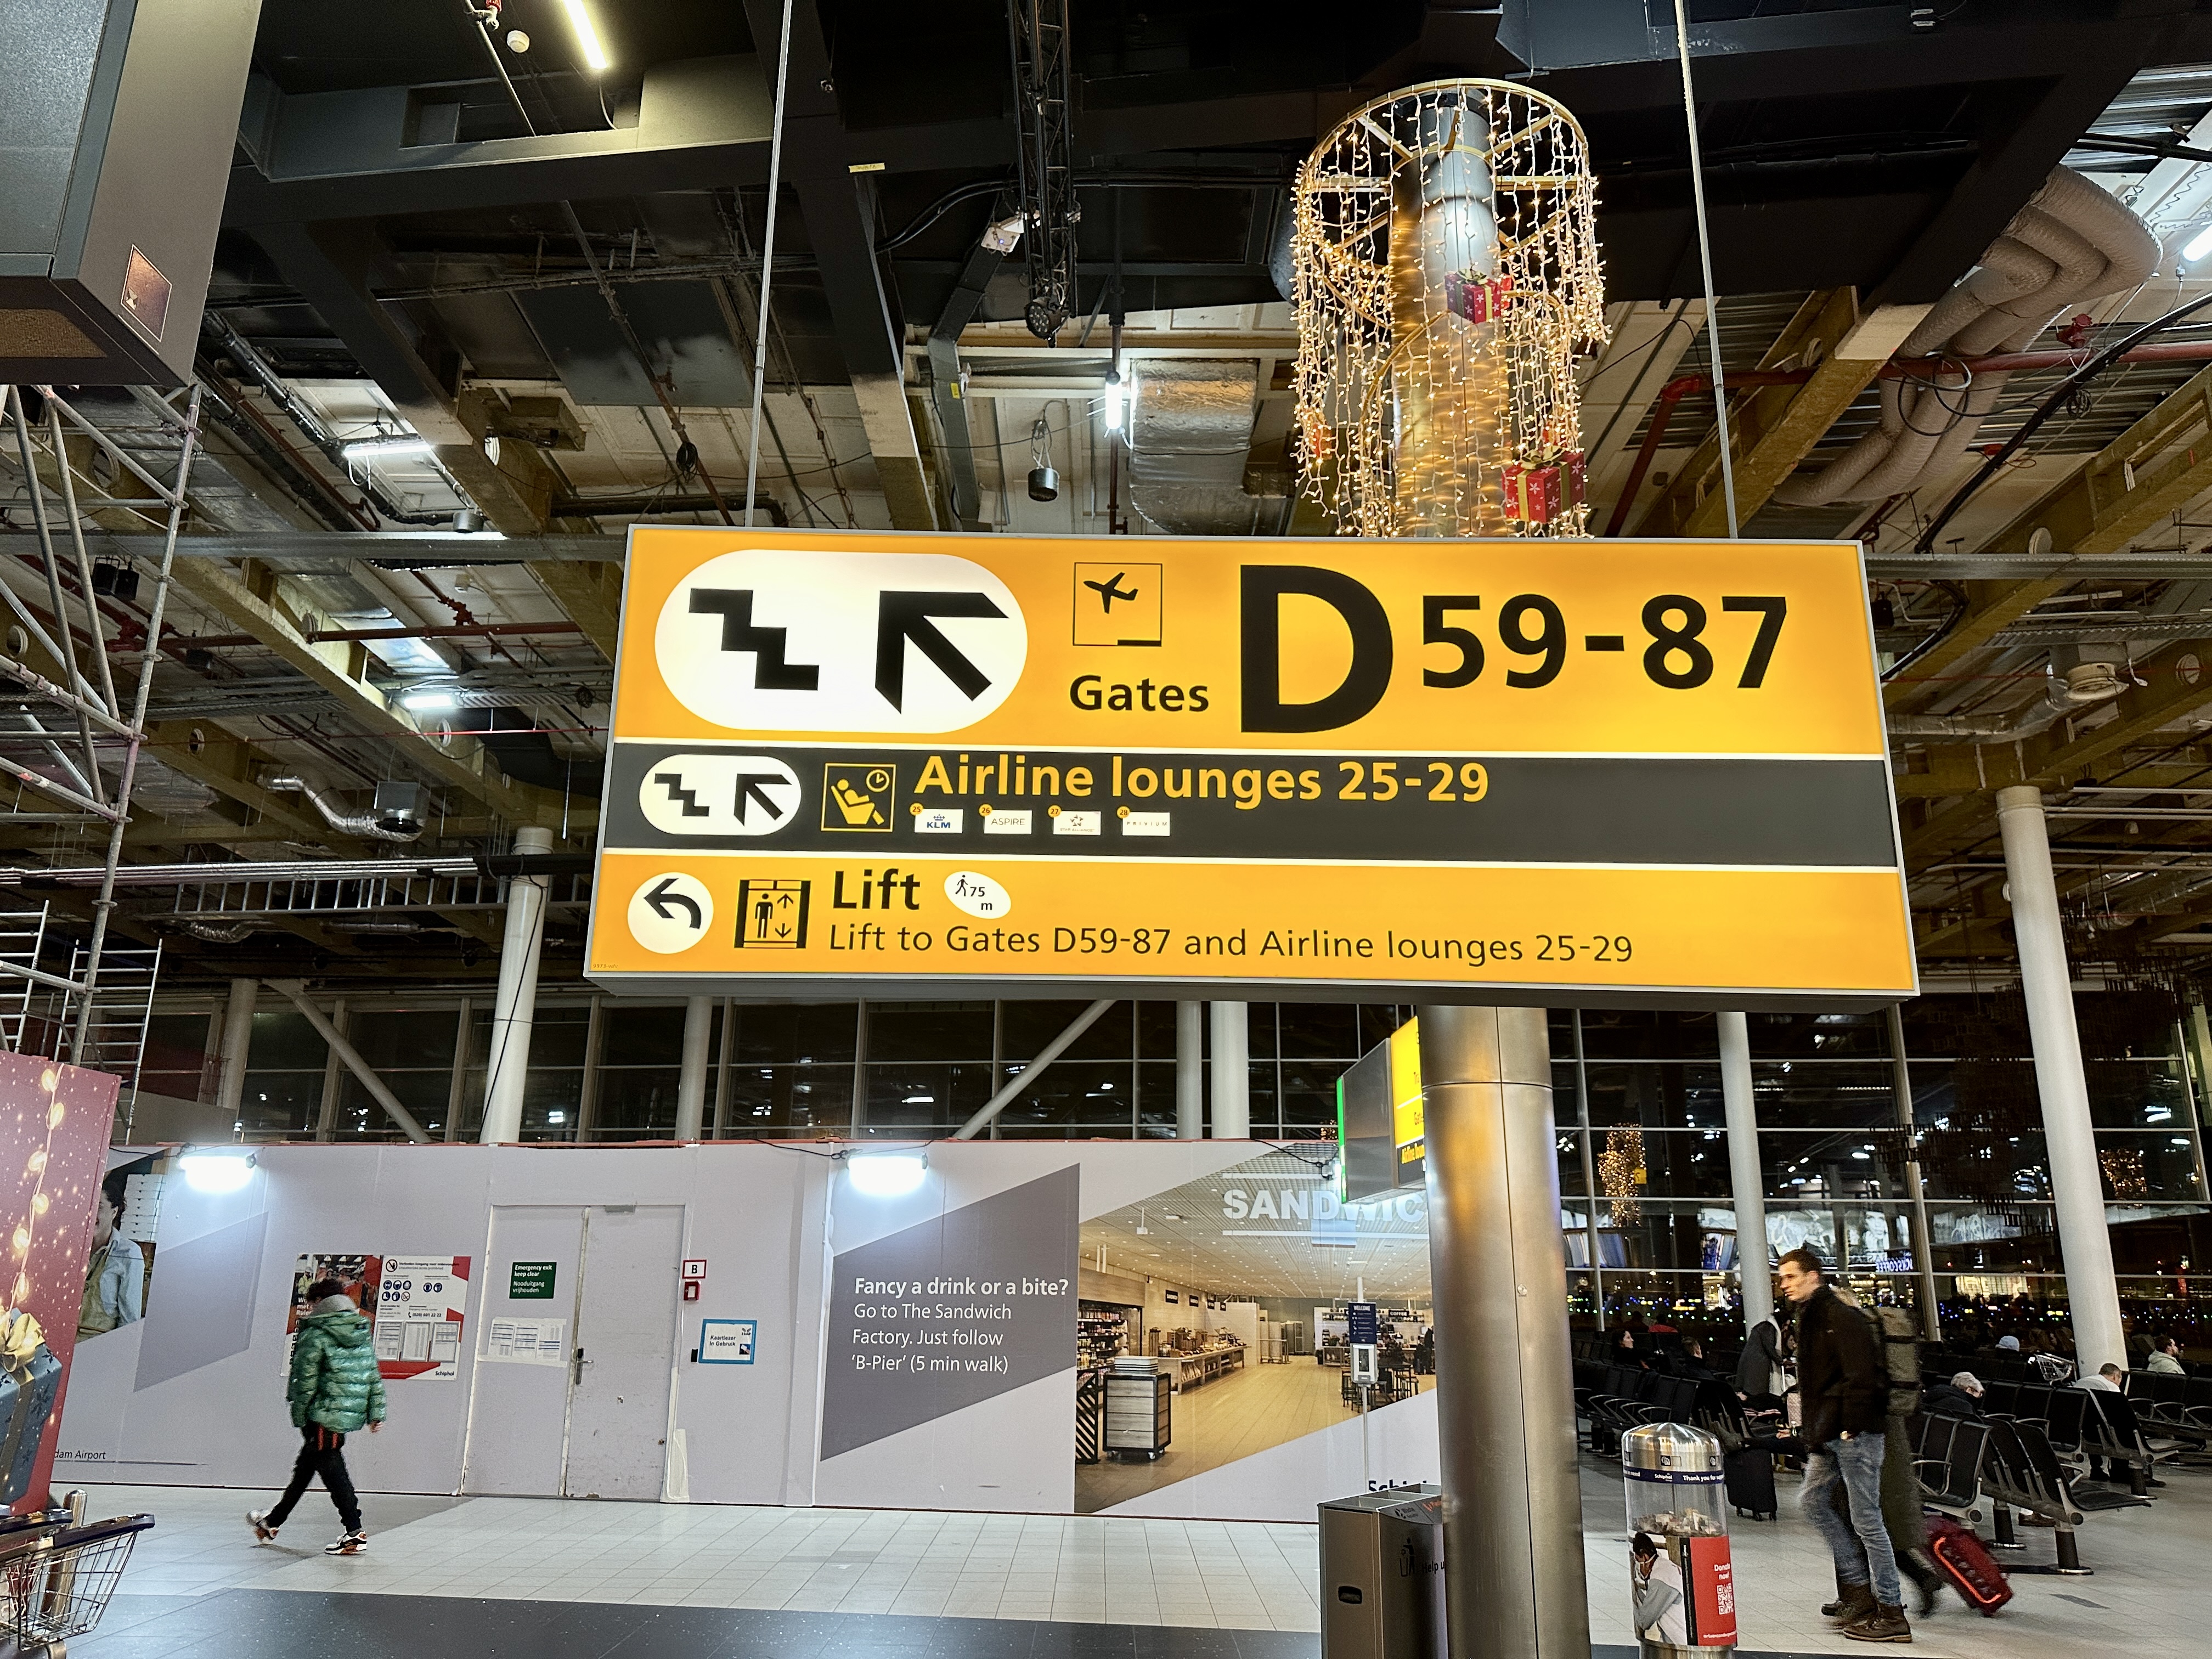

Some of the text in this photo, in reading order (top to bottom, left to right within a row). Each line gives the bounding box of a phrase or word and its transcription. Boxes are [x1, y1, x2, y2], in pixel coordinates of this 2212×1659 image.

[1070, 565, 1787, 733] Gates D 59-87
[915, 754, 1489, 810] Airline lounges 25-29
[833, 868, 921, 910] Lift
[969, 887, 985, 897] 75
[981, 902, 992, 911] m
[830, 923, 1633, 967] Lift to Gates D59-87 and Airline lounges 25-29
[1223, 1189, 1424, 1222] SANDWIC
[691, 1265, 698, 1274] B
[855, 1277, 1069, 1298] Fancy a drink or a bite?
[854, 1302, 1012, 1319] Go to The Sandwich
[853, 1329, 1003, 1348] Factory. Just follow
[910, 1354, 926, 1373] (5
[930, 1356, 960, 1372] min
[964, 1355, 1008, 1375] walk)
[54, 1449, 106, 1461] dam Airport
